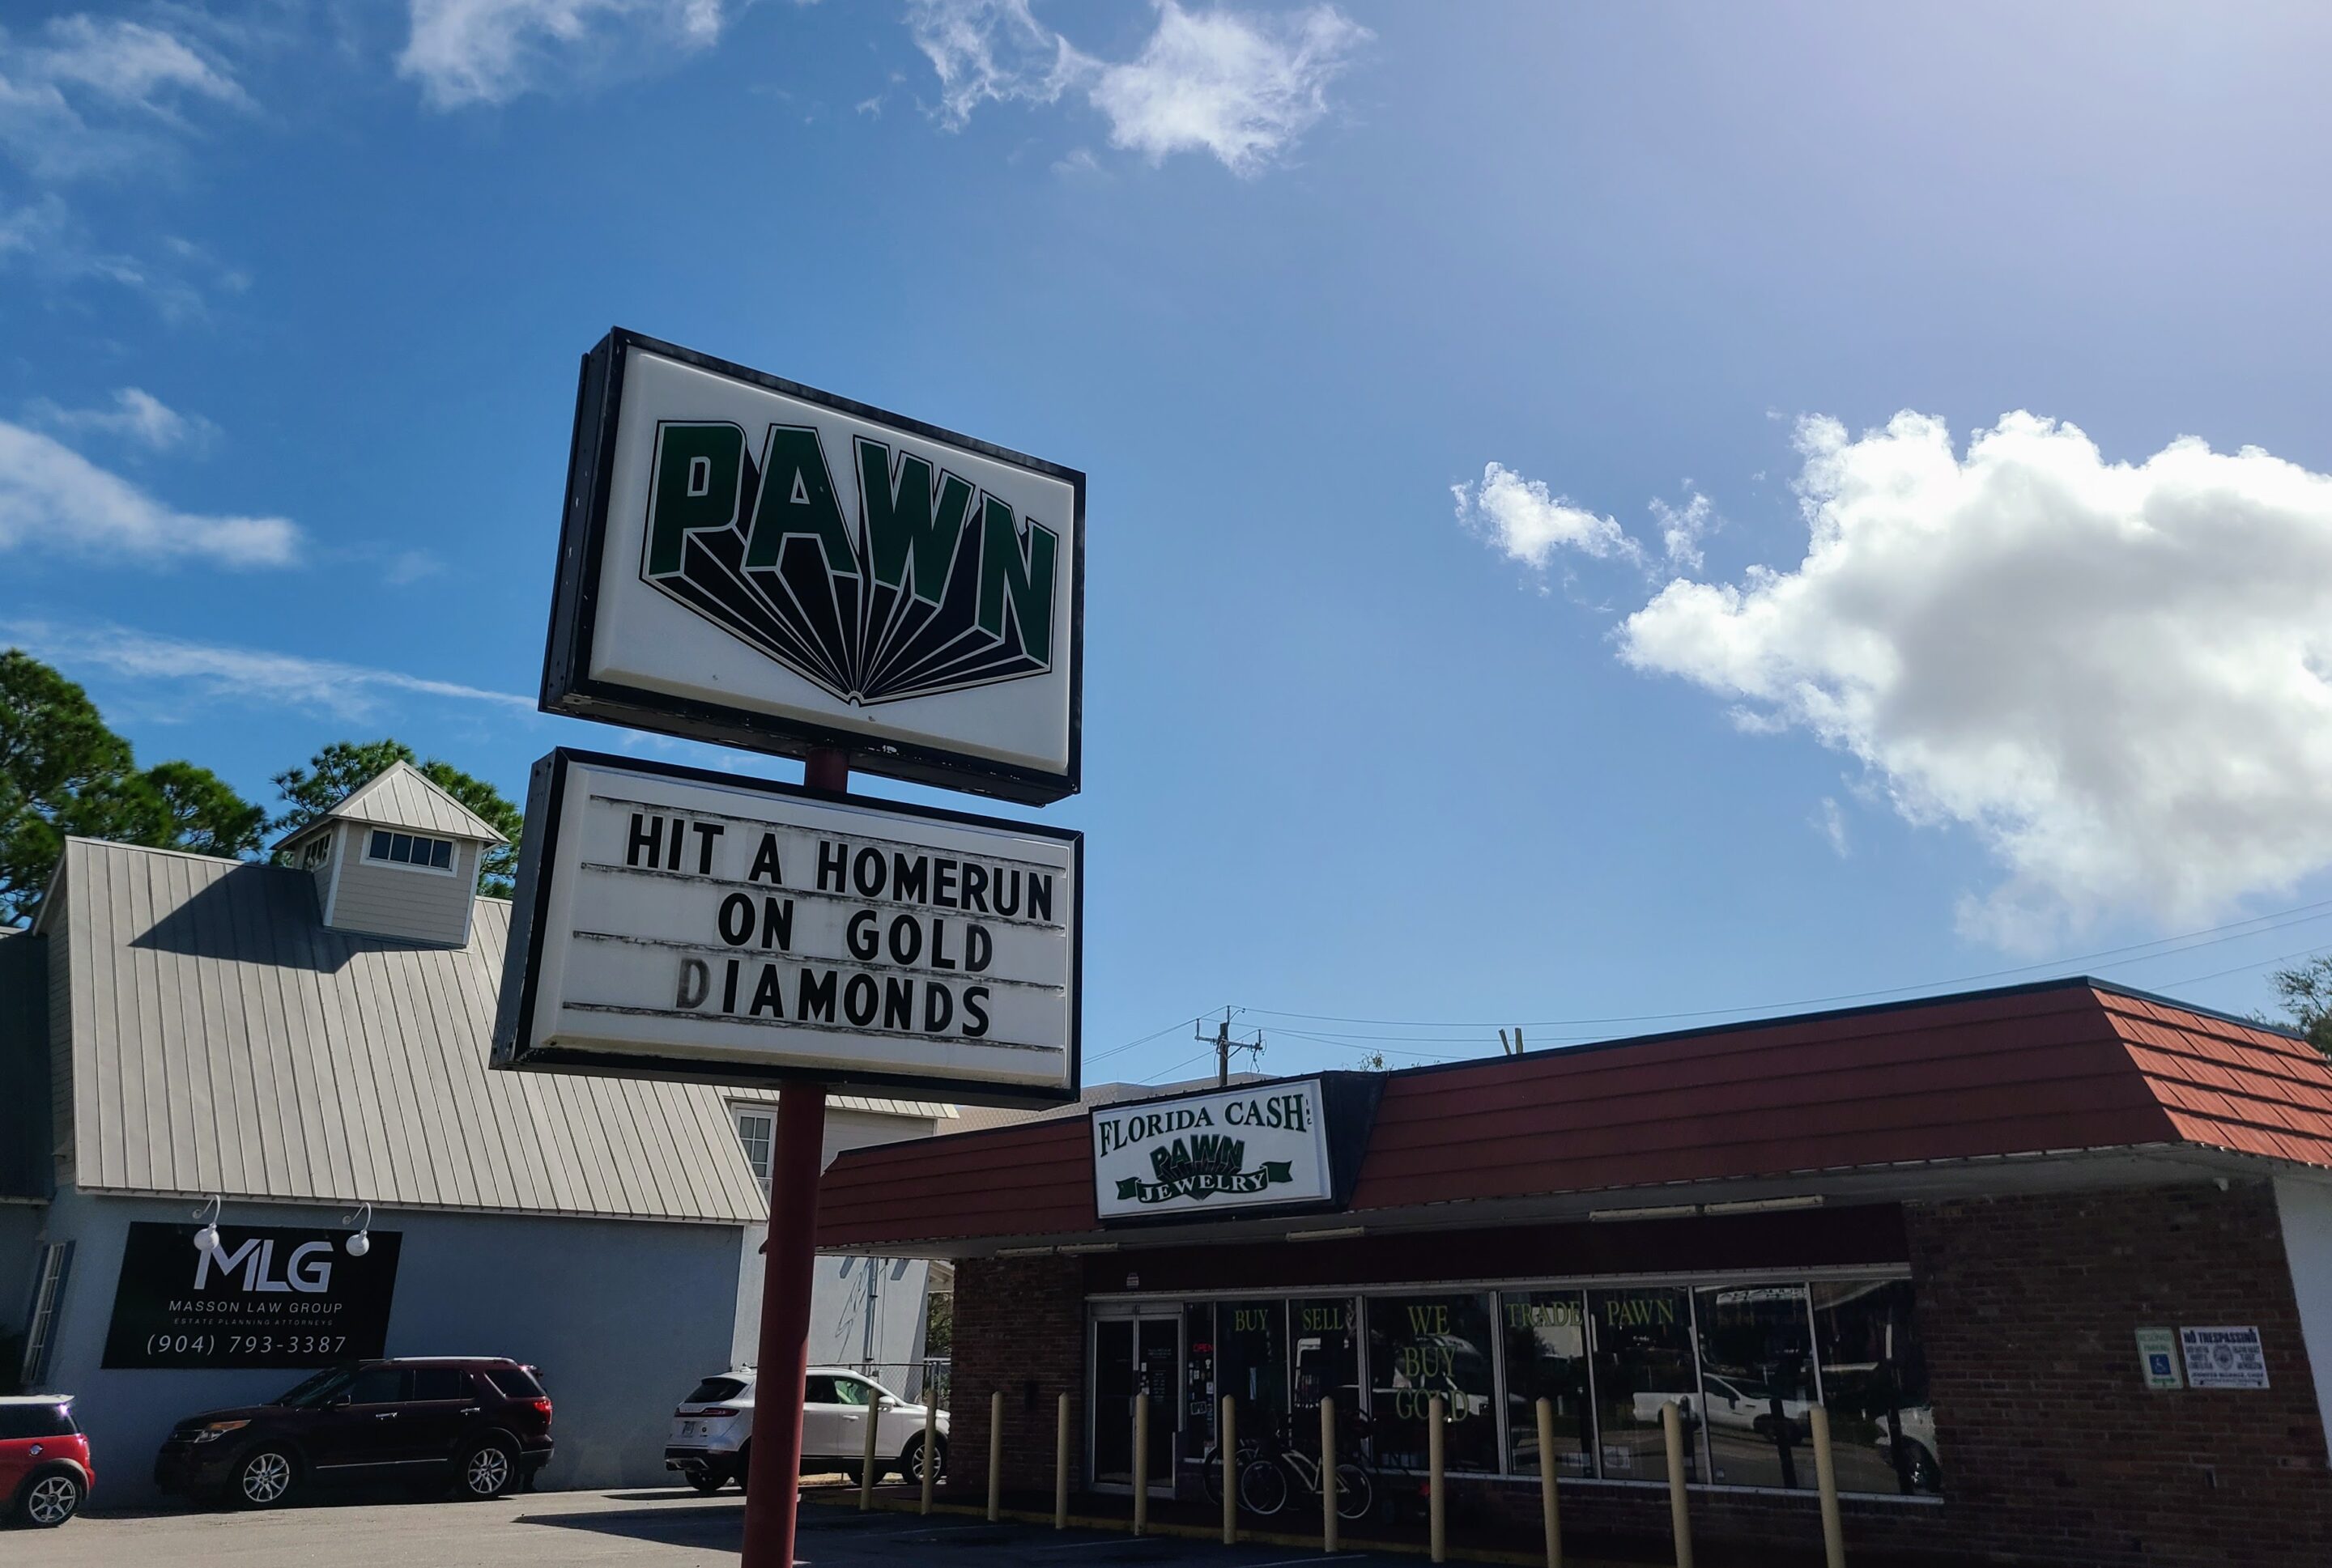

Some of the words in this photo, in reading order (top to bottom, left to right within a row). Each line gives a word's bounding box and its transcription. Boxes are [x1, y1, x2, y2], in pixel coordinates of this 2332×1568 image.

[640, 419, 1059, 674] PAWN
[627, 812, 725, 875] HIT
[748, 833, 783, 885] A
[816, 839, 1053, 922] HOMERUN
[718, 892, 794, 951] ON
[846, 909, 994, 973] GOLD
[676, 957, 991, 1038] DIAMONDS
[1099, 1106, 1214, 1158] FLORIDA
[1224, 1094, 1307, 1132] CASH
[1150, 1133, 1245, 1177] PAWN
[1140, 1173, 1266, 1202] JEWELRY
[194, 1238, 334, 1293] MLG
[168, 1300, 240, 1311] MASSON
[247, 1302, 283, 1313] LAW
[289, 1302, 343, 1314] GROUP
[1234, 1308, 1269, 1332] BUY
[1302, 1307, 1344, 1331] SELL
[1407, 1304, 1451, 1336] WE
[1504, 1301, 1584, 1328] TRADE
[1606, 1298, 1675, 1326] PAWN
[147, 1333, 215, 1355] (904)
[229, 1336, 347, 1353] 793-3387
[1403, 1346, 1458, 1379] BUY
